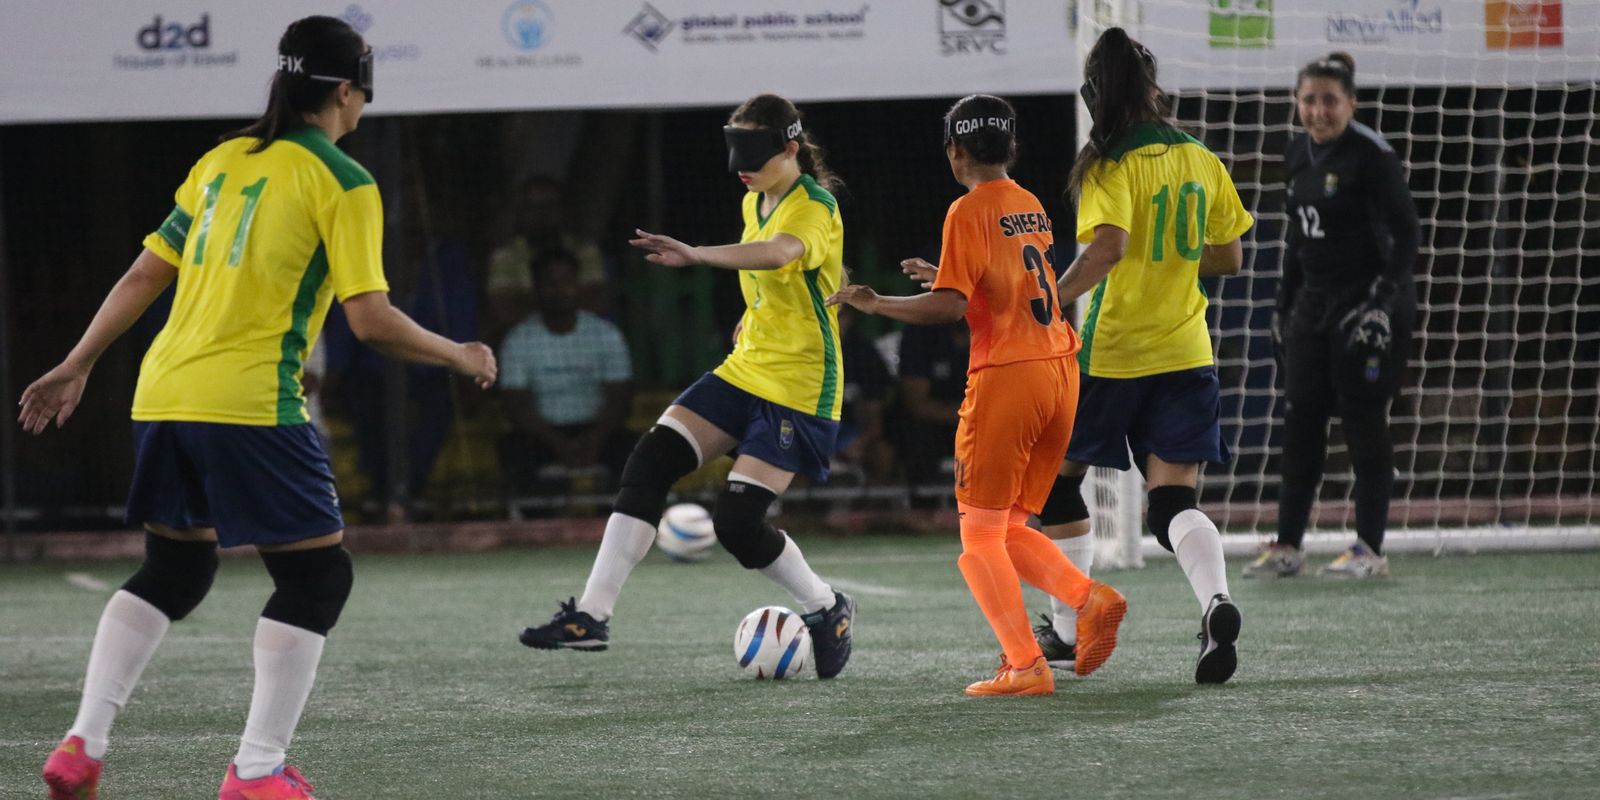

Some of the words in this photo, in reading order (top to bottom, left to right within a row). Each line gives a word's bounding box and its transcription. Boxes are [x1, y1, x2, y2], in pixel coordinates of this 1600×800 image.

[138, 13, 209, 50] d2d
[682, 15, 737, 30] global
[743, 13, 798, 29] public
[805, 13, 865, 26] school
[941, 34, 1006, 56] SRVC
[192, 172, 269, 267] 11
[1151, 181, 1207, 262] 10
[1297, 204, 1326, 239] 12
